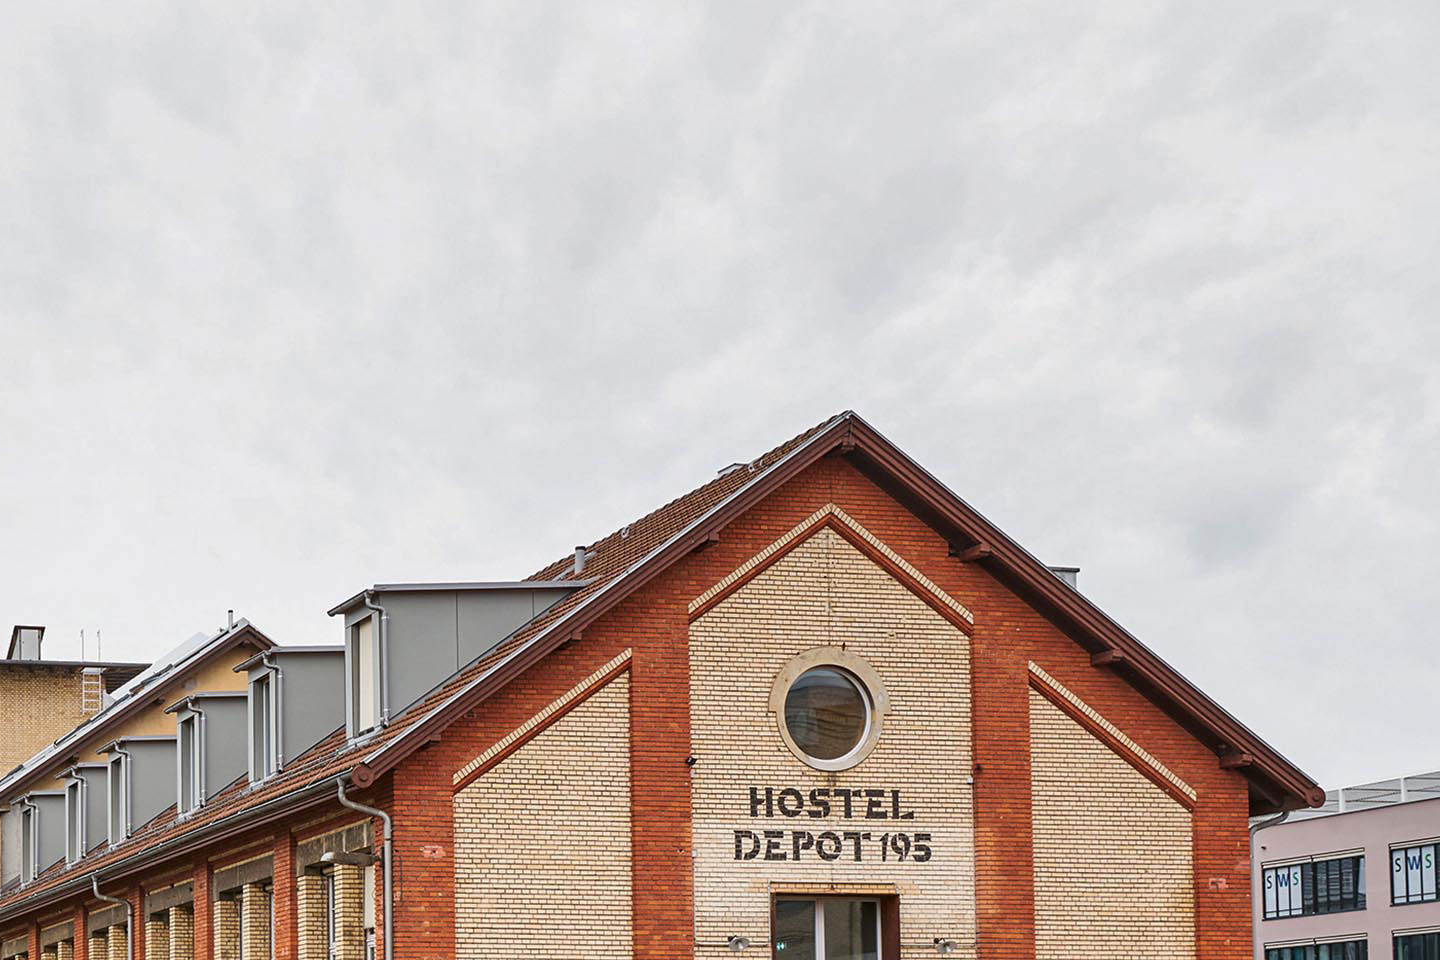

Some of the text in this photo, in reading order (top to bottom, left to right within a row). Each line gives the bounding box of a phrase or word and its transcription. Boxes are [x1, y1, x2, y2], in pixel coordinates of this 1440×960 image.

[749, 787, 915, 819] HOSTEL
[733, 830, 932, 863] DEPOT 195
[1394, 853, 1432, 873] SWS
[1267, 872, 1299, 889] SWS
